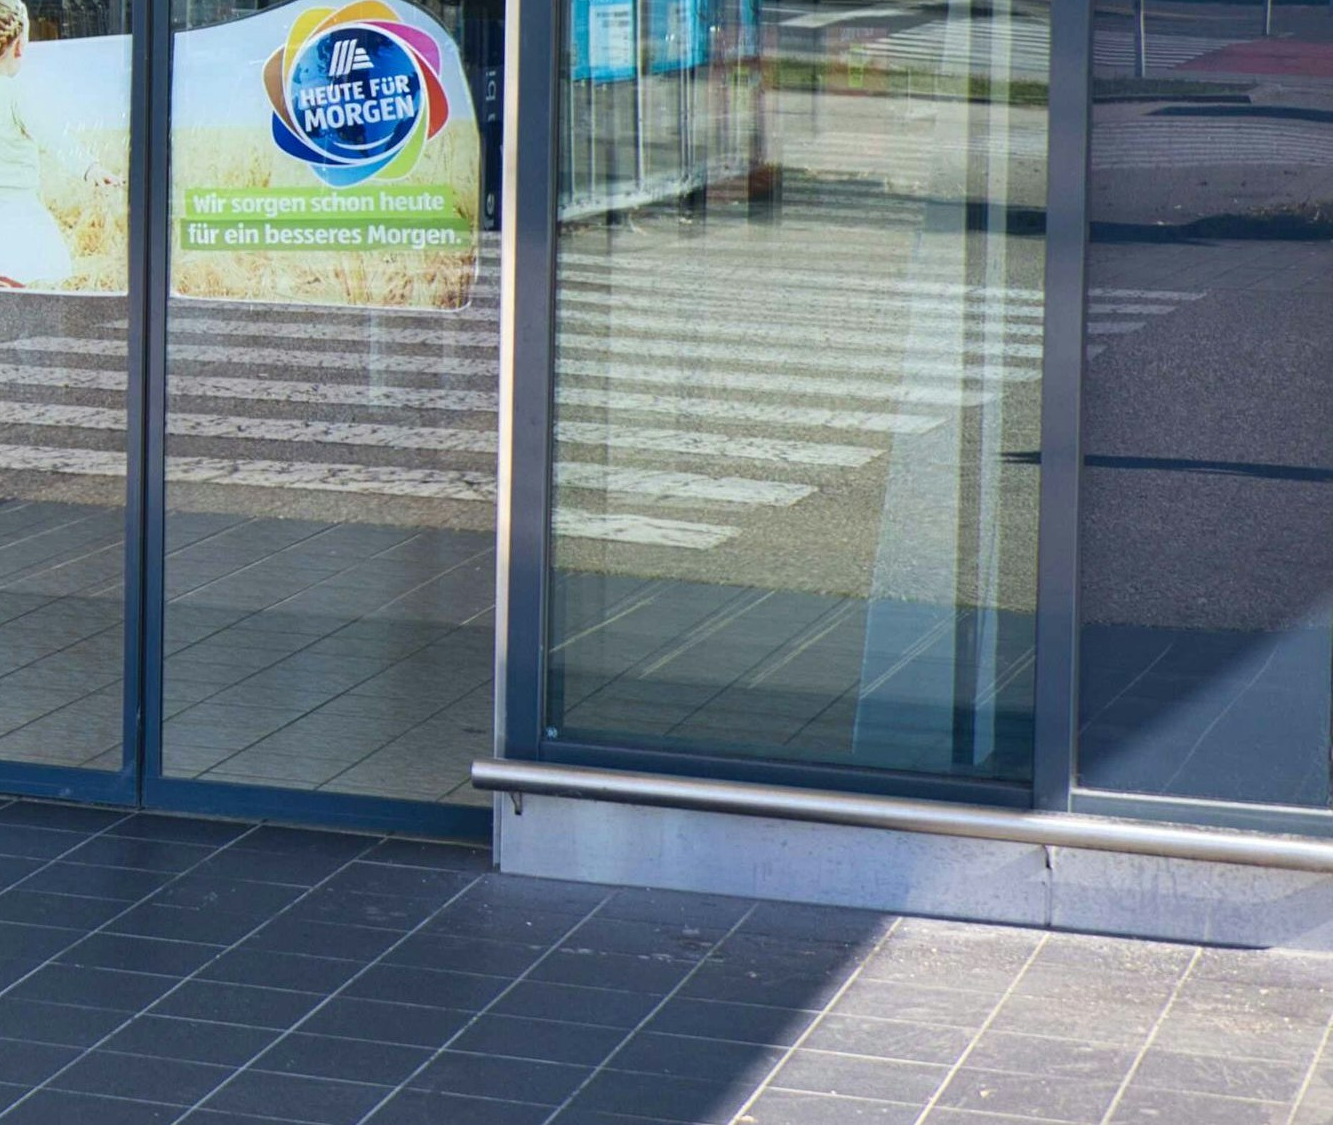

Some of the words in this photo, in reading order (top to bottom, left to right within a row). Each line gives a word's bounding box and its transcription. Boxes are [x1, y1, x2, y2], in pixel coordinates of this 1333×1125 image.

[300, 83, 364, 108] HEUTE
[368, 74, 410, 102] FÜR
[303, 94, 415, 132] MORGEN
[193, 193, 228, 214] Wir
[231, 194, 305, 219] sorgen
[310, 191, 375, 214] schon
[379, 191, 445, 212] heute
[188, 221, 218, 245] für
[224, 222, 260, 244] ein
[264, 222, 362, 244] besseres
[366, 223, 462, 249] Morgen.
